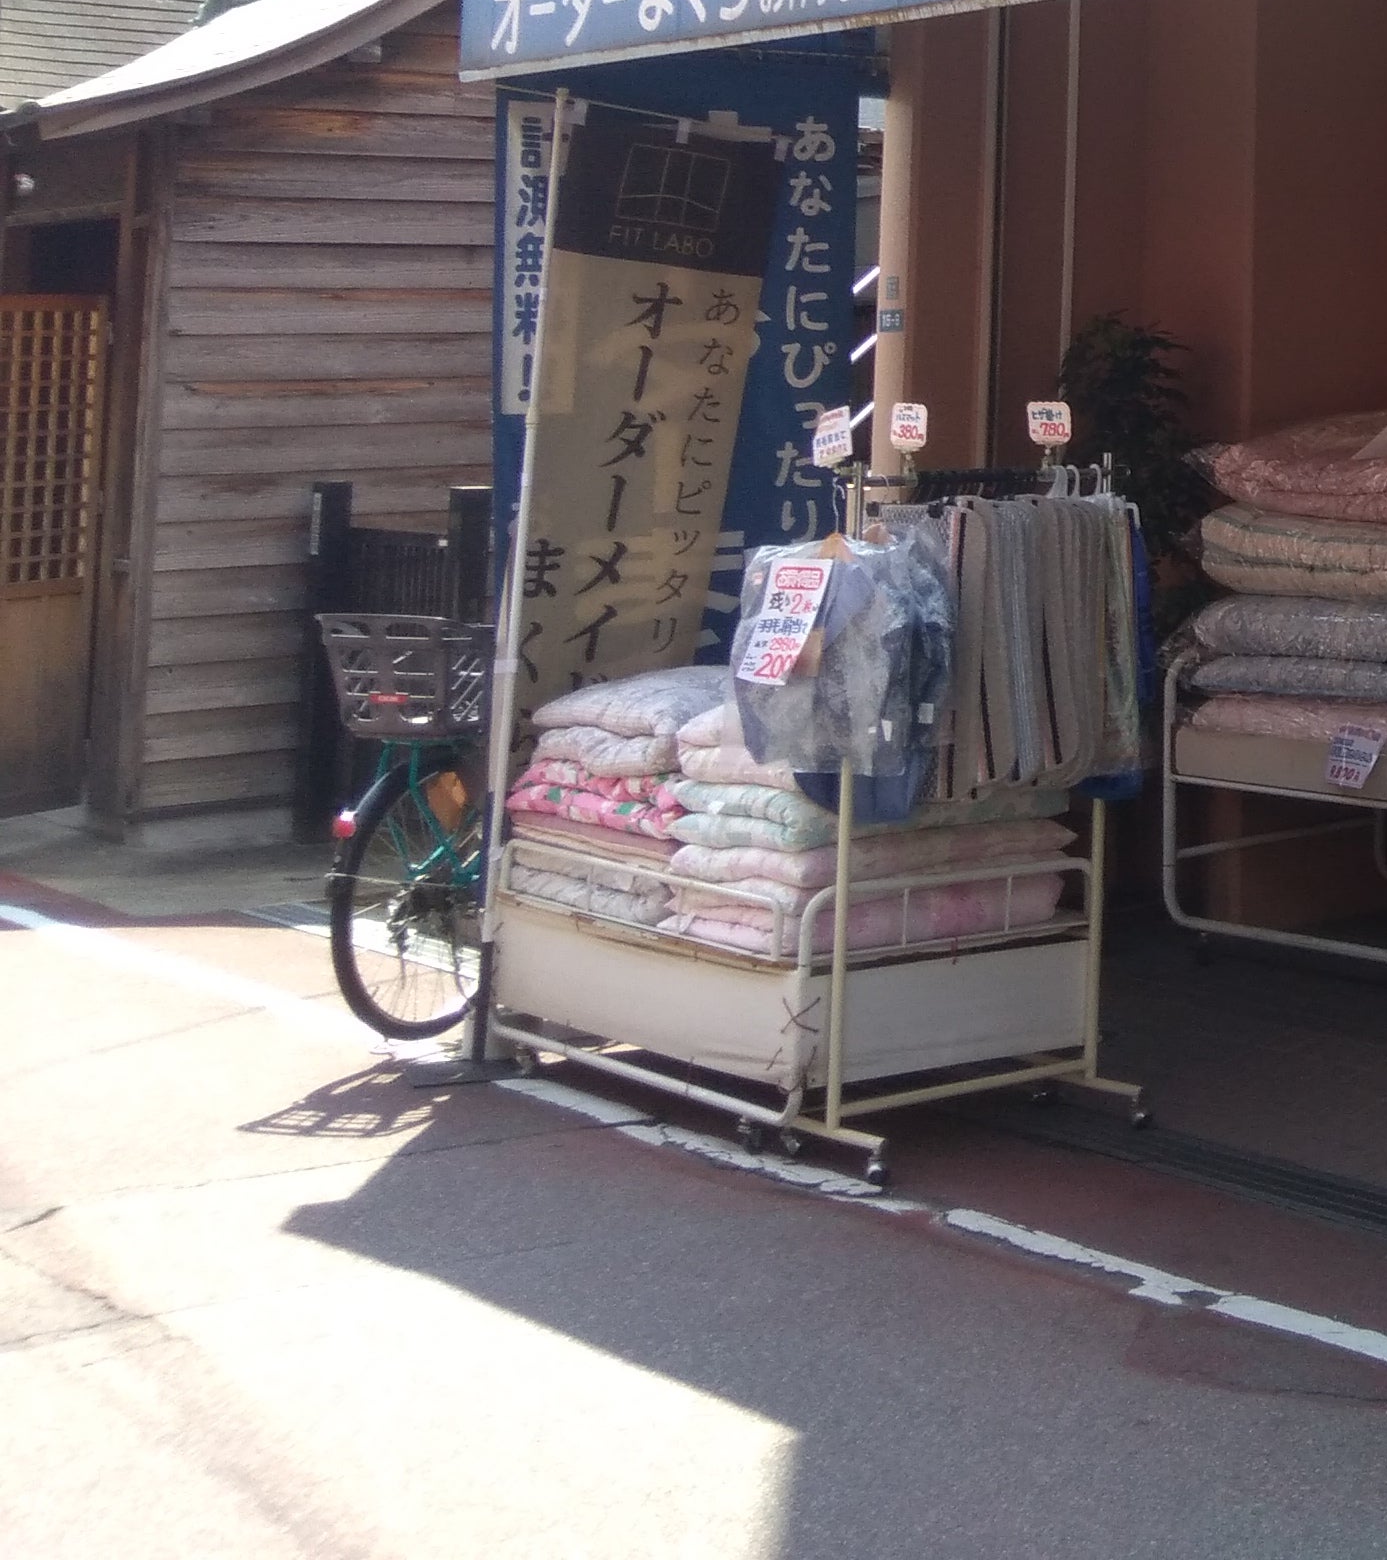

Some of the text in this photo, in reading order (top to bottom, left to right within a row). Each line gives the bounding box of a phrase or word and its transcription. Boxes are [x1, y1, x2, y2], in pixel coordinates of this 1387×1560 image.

[607, 223, 714, 258] FIT LABO
[776, 115, 837, 543] あなたにぴったり
[651, 287, 742, 654] あなたにピッタリ
